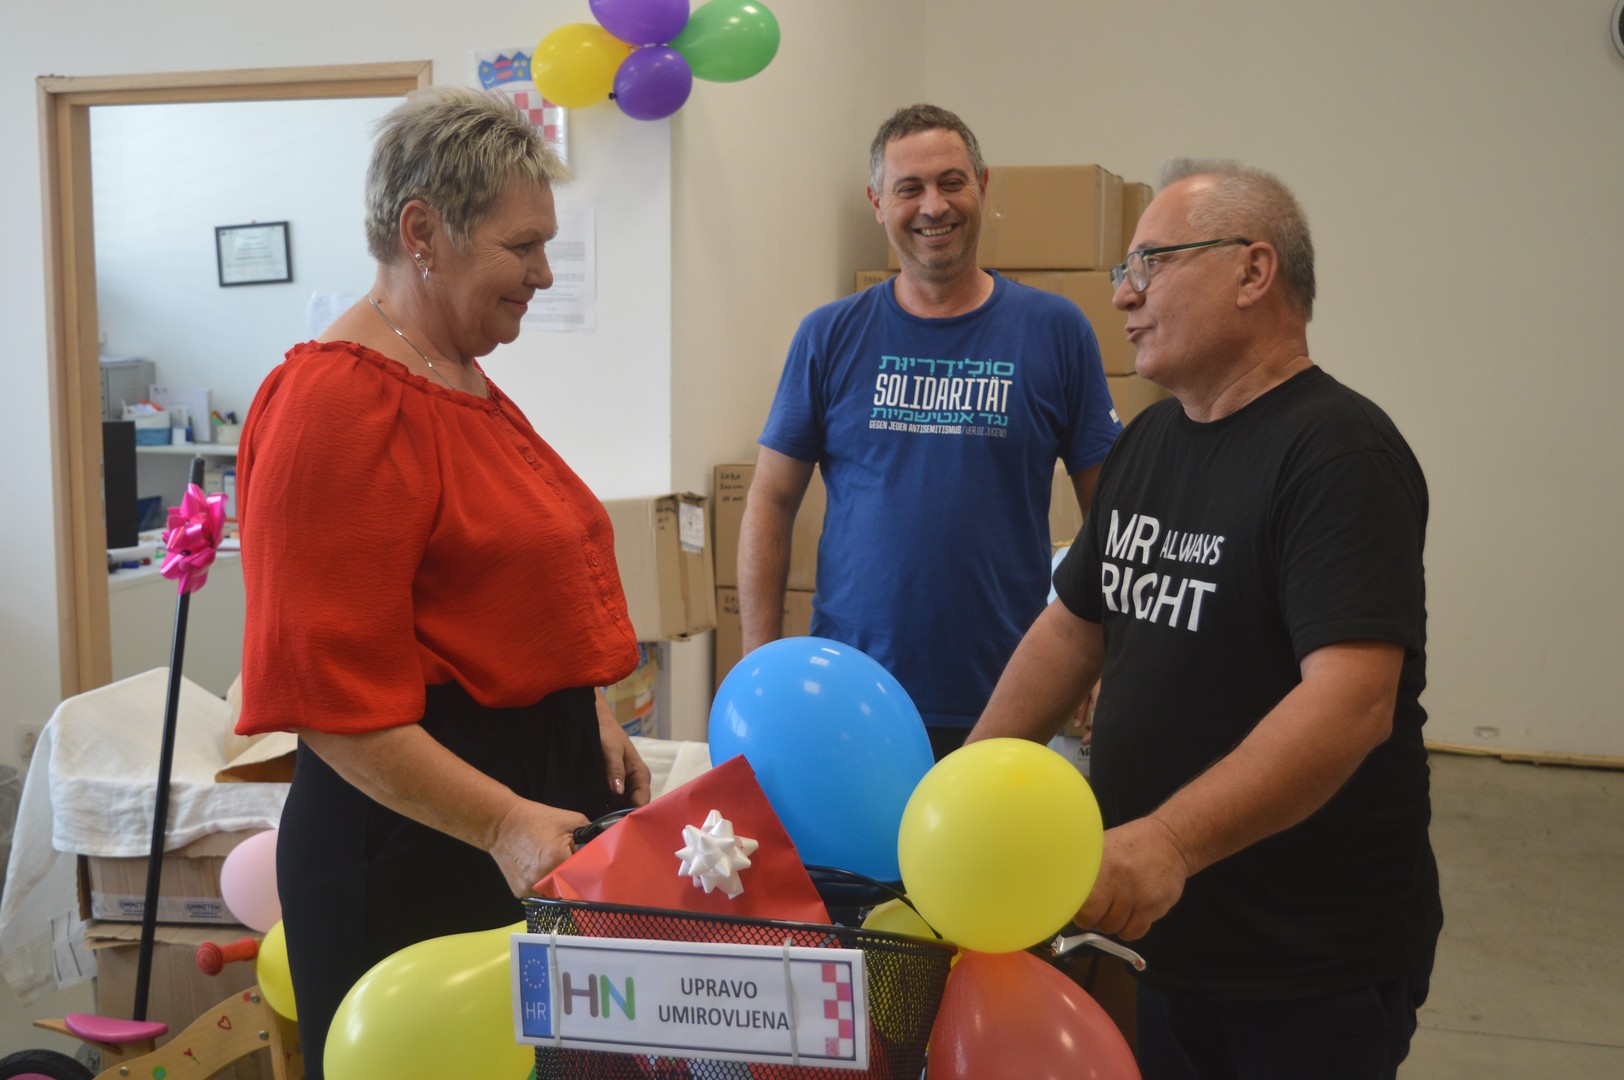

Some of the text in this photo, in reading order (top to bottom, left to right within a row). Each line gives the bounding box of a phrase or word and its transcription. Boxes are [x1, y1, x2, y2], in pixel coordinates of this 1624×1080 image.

[873, 373, 1013, 413] SOLIDARITÄT
[868, 420, 888, 430] GEGEN
[888, 421, 907, 431] JEDEN
[908, 423, 962, 434] ANTISEMITISMUS
[870, 407, 1009, 426] נגד אנטישמיות
[1105, 509, 1225, 566] MR ALWAYS
[1101, 561, 1217, 632] RIGHT
[562, 971, 636, 1021] HN
[681, 977, 758, 999] UPRAVO
[525, 1001, 547, 1020] HR
[658, 1005, 790, 1031] UMIROVLJENA
